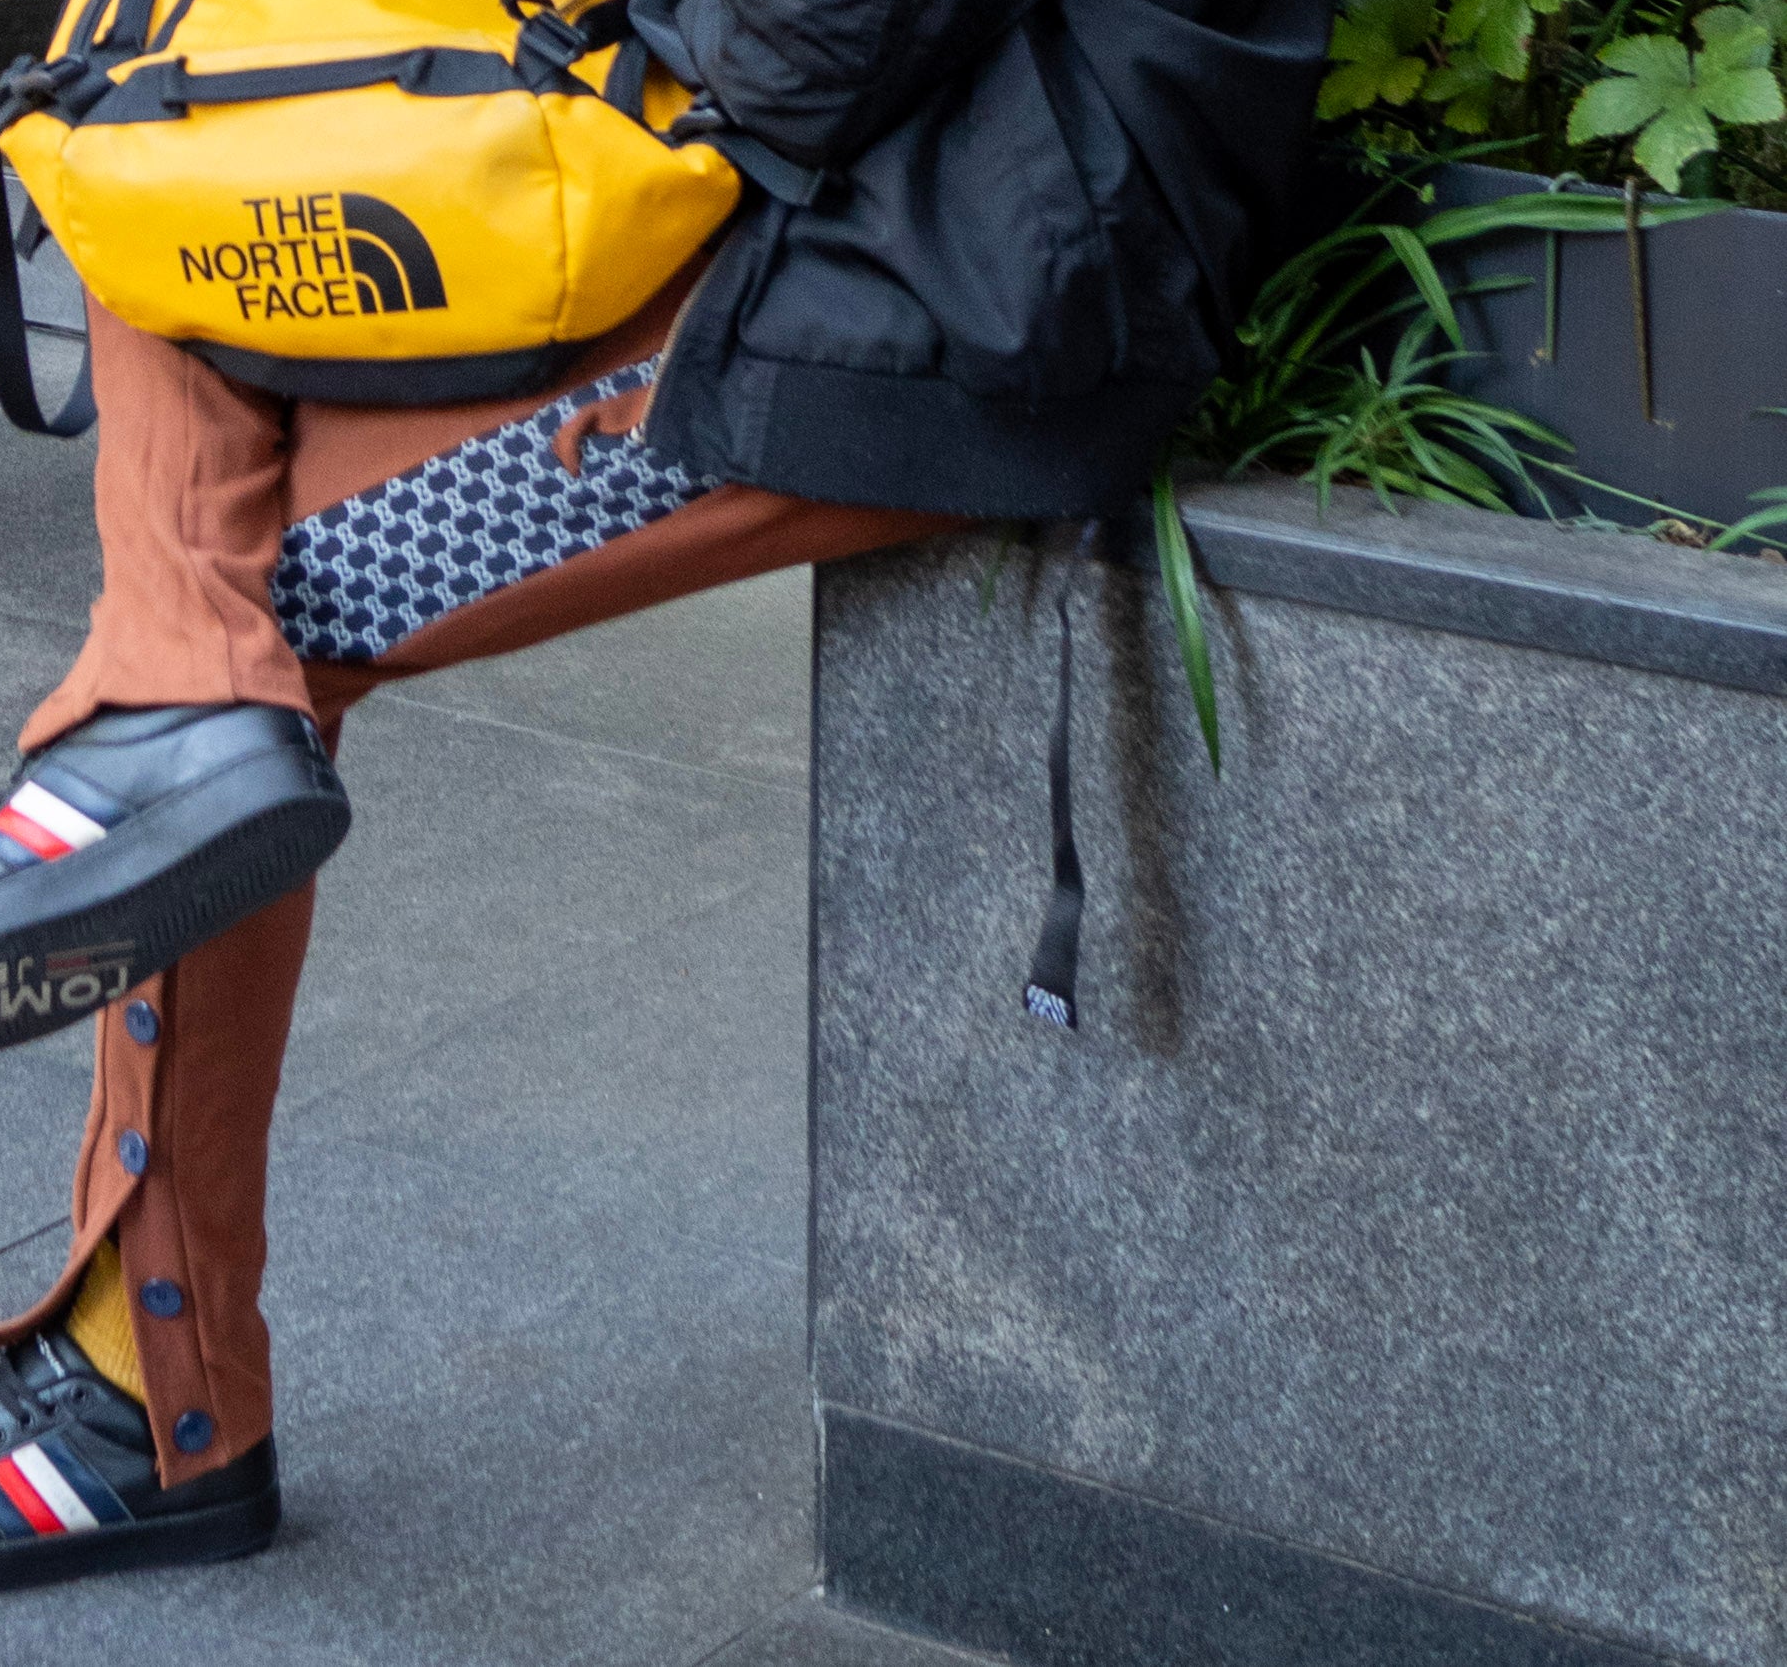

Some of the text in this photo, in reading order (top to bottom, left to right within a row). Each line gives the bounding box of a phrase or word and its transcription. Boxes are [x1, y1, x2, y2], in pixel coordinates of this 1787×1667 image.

[243, 192, 338, 237] THE
[178, 235, 346, 283] NORTH
[236, 279, 356, 321] FACE
